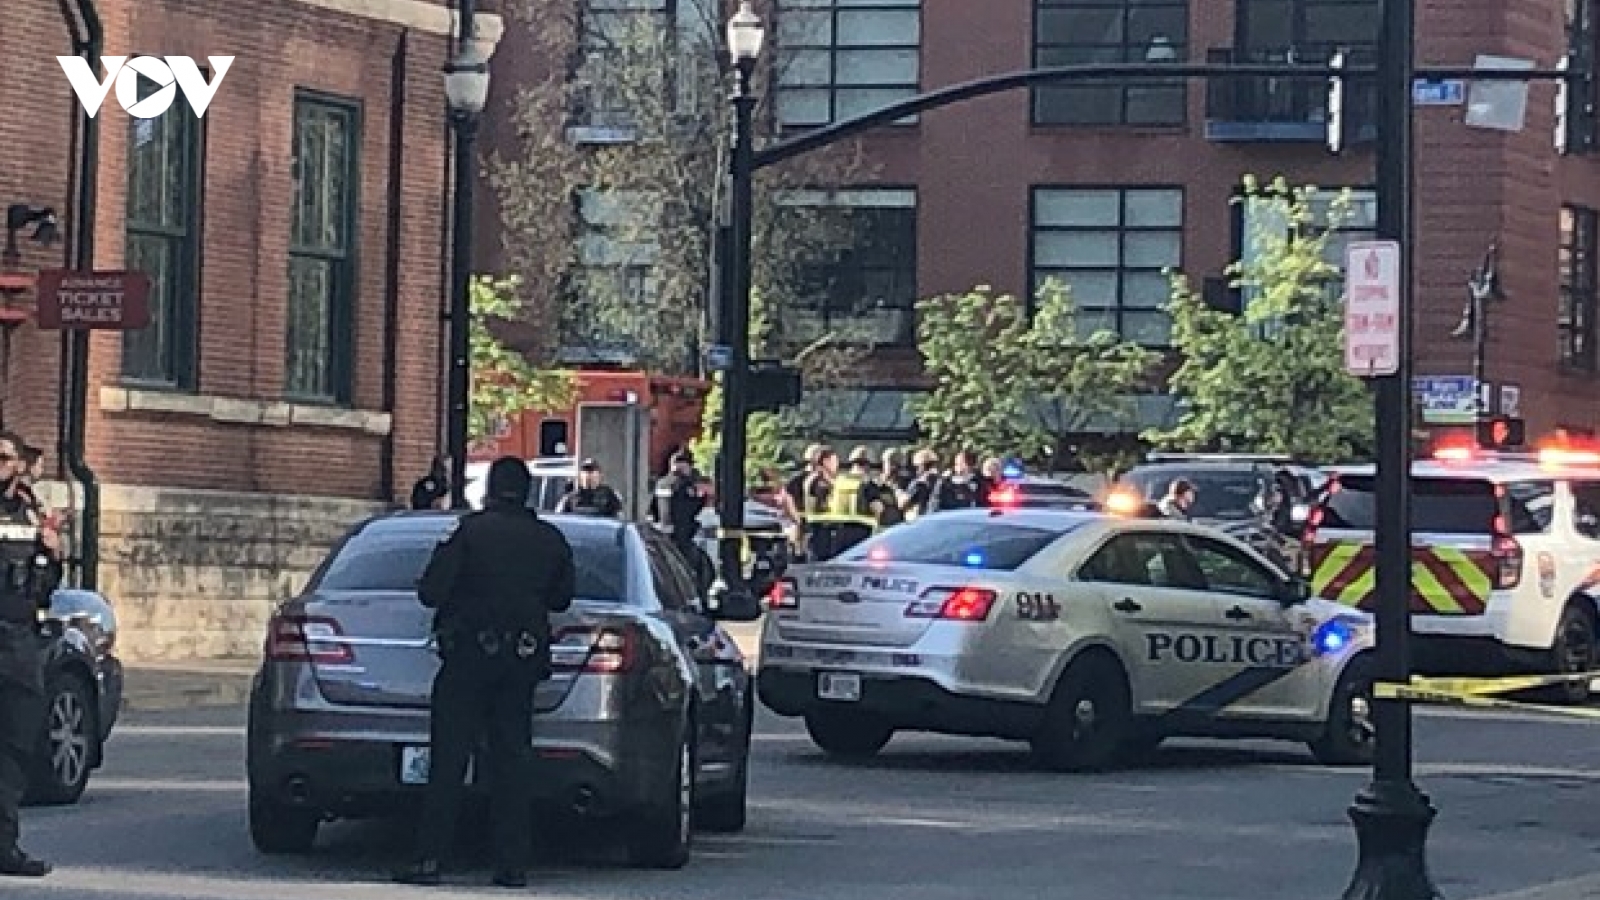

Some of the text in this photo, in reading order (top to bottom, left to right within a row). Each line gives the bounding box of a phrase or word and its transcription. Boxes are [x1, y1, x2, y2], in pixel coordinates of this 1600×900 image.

[57, 291, 124, 305] TICKET
[61, 307, 122, 321] SALES
[1146, 633, 1301, 665] POLICE
